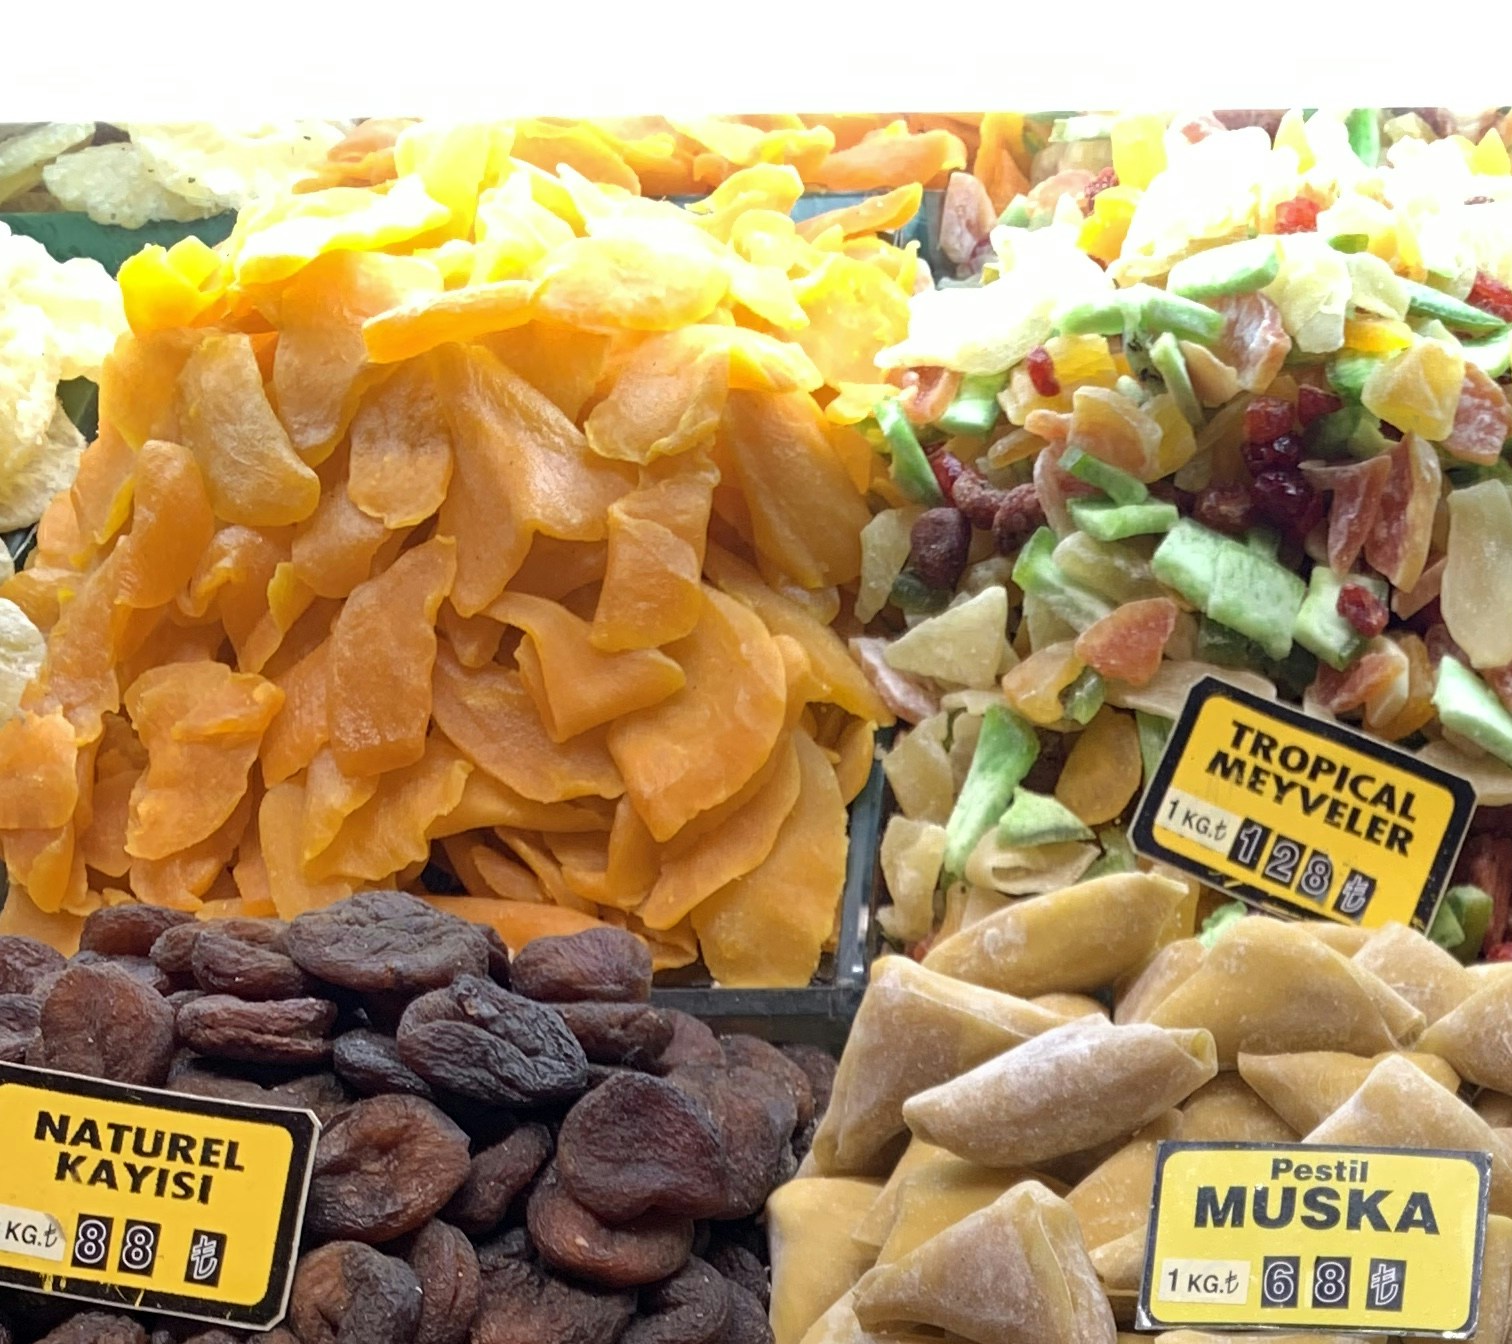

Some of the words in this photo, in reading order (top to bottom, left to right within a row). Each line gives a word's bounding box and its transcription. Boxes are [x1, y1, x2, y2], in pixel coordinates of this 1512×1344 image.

[1232, 719, 1417, 824] TROPICAL
[1165, 798, 1180, 821] 1
[1205, 750, 1414, 858] MEYVELER
[34, 1110, 245, 1172] NATUREL
[54, 1151, 214, 1205] KAYISI
[1271, 1157, 1369, 1183] Pestil
[1193, 1185, 1440, 1236] MUSKA
[1168, 1269, 1179, 1292] 1
